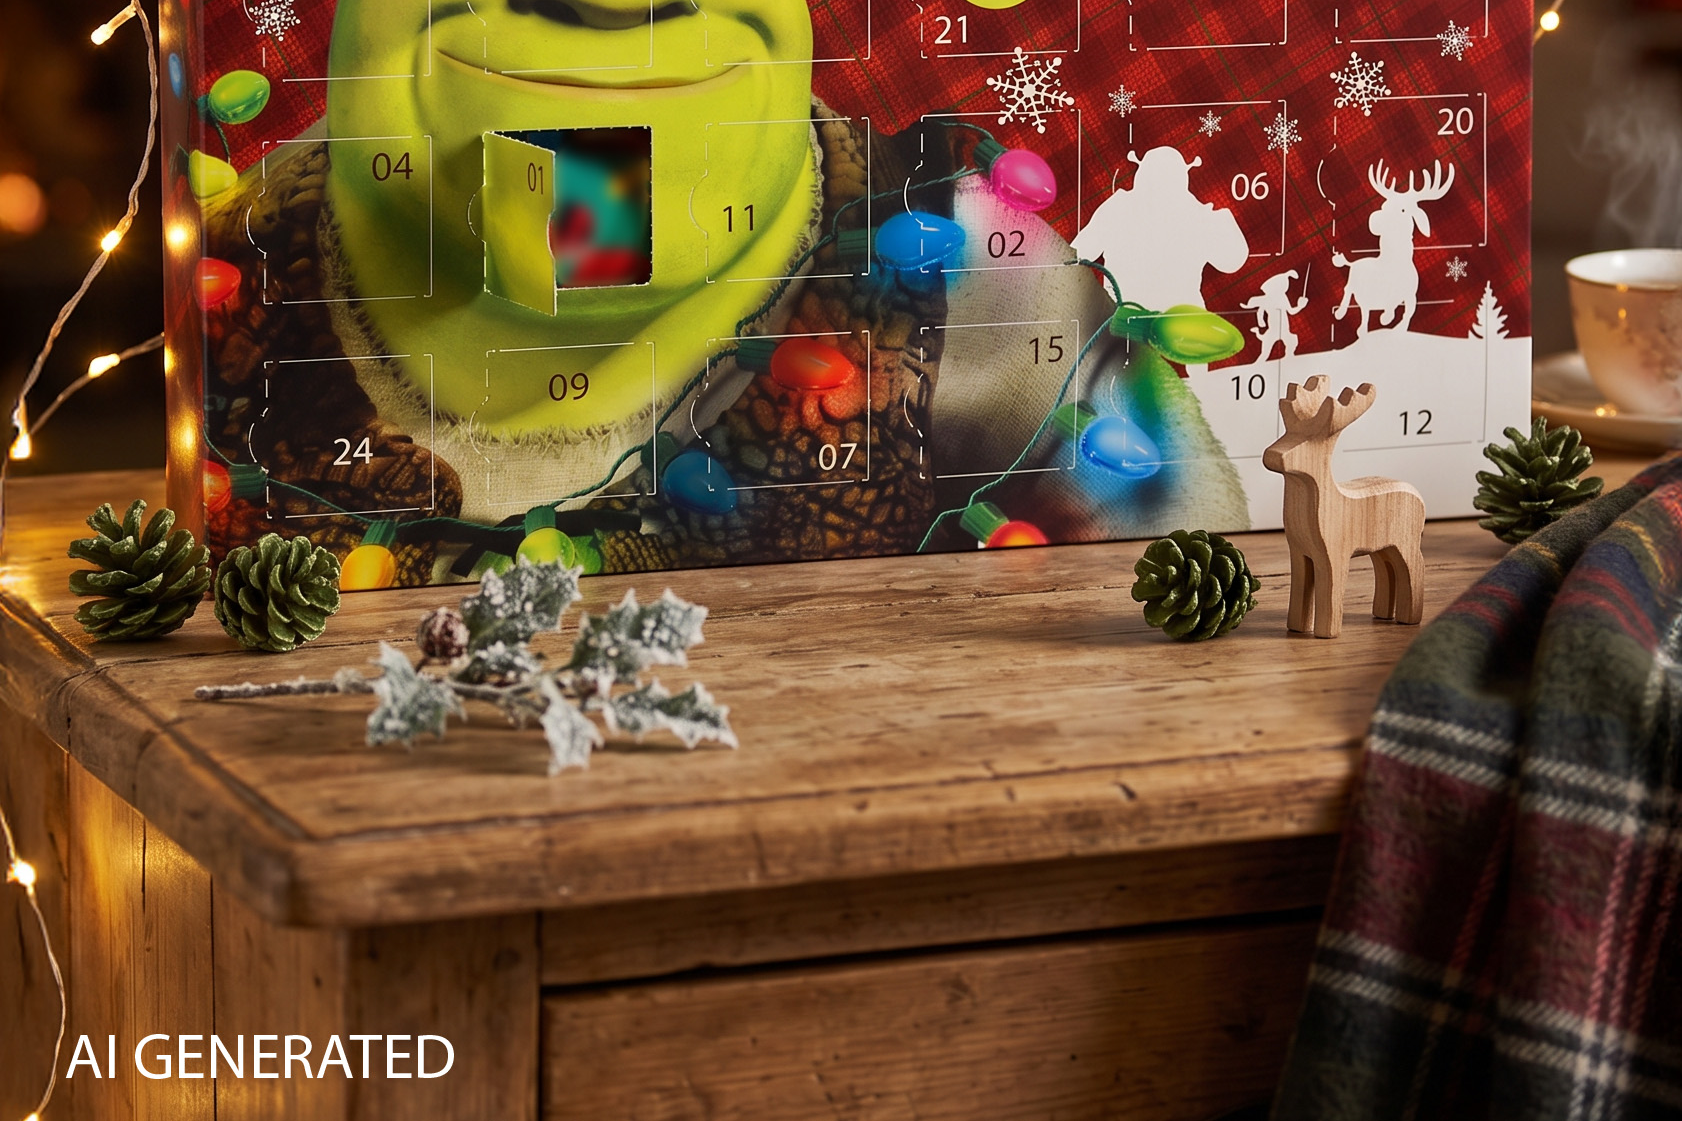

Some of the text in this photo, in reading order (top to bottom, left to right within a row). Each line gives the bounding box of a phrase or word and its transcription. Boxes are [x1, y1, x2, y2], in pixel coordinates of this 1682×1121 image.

[934, 15, 970, 44] 21
[1437, 107, 1475, 137] 20
[371, 151, 413, 182] 04
[526, 161, 545, 195] 01
[1230, 172, 1270, 202] 06
[722, 205, 756, 234] 11
[987, 230, 1027, 259] 02
[1029, 336, 1064, 365] 15
[548, 372, 590, 402] 09
[1231, 373, 1266, 402] 10
[1398, 408, 1433, 437] 12
[332, 436, 374, 467] 24
[818, 443, 857, 472] 07
